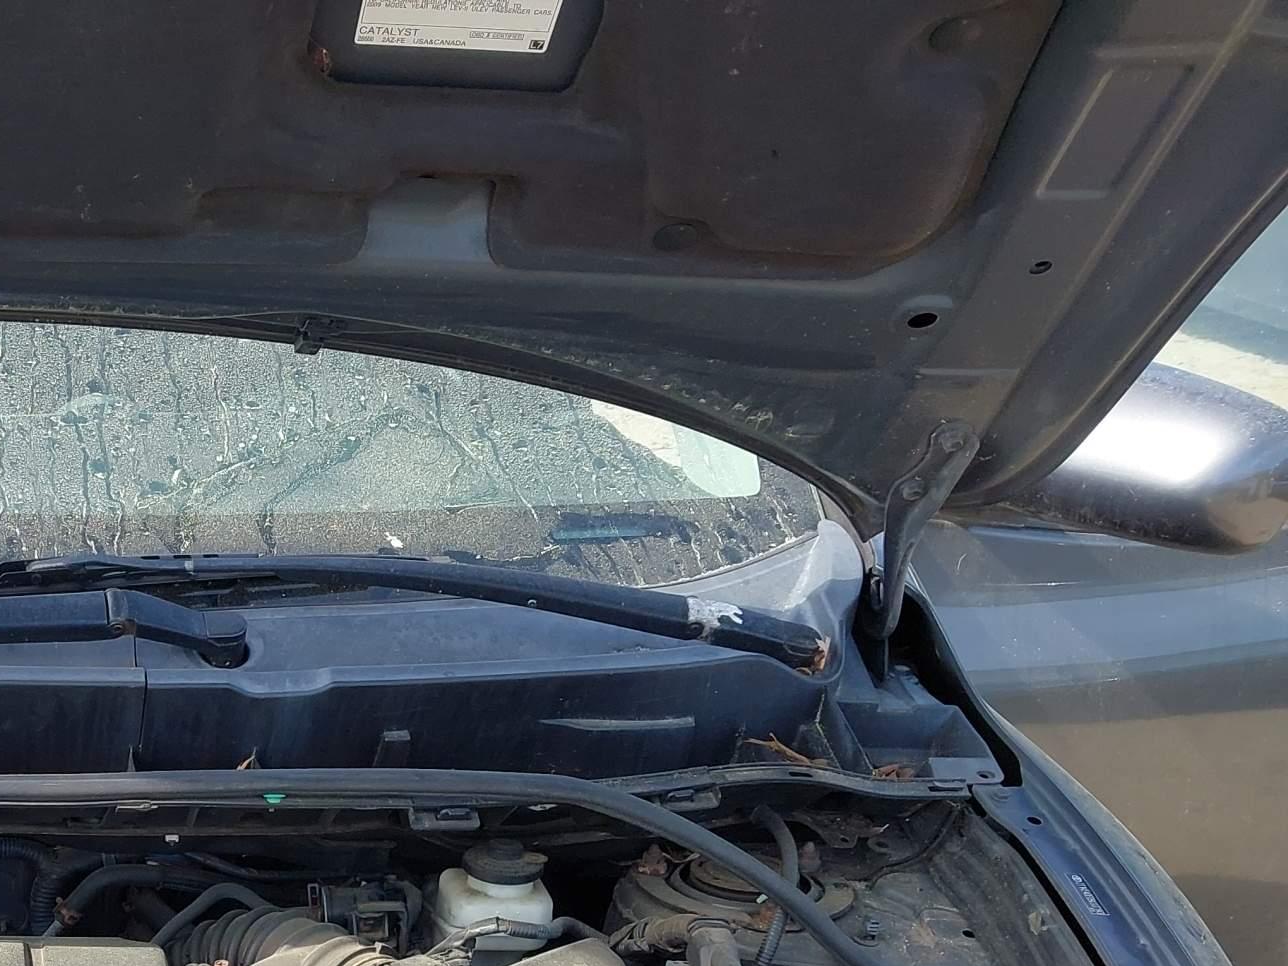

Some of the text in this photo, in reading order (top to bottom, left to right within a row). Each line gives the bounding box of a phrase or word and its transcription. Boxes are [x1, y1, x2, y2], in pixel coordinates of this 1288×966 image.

[492, 6, 531, 15] PASSENGER
[359, 26, 420, 37] CATALYST
[413, 39, 466, 47] USA&CANADA
[530, 40, 544, 49] L7
